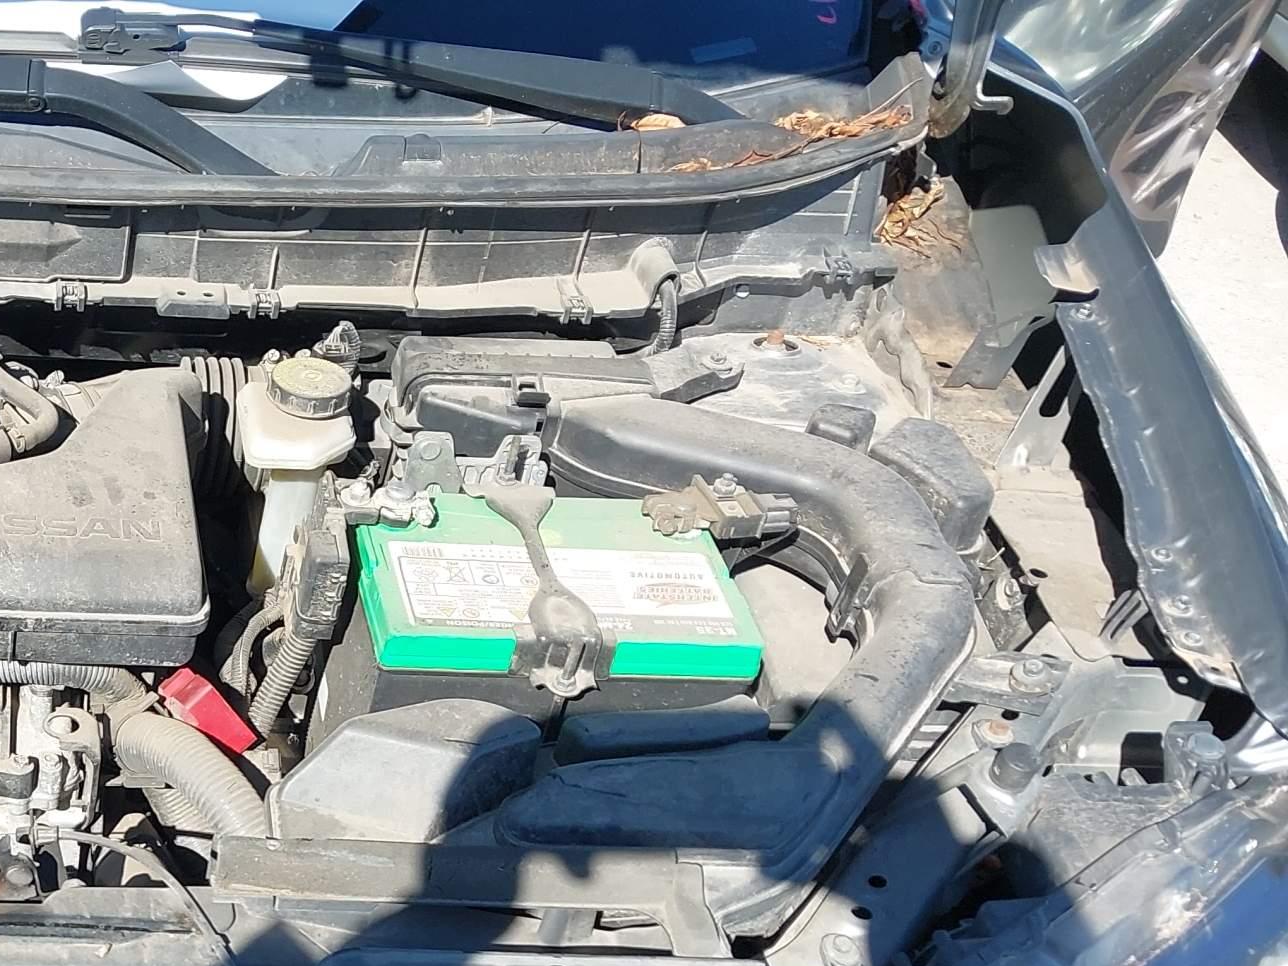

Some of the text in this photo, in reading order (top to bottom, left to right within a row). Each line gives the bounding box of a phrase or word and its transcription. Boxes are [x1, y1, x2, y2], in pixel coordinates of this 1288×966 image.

[629, 571, 704, 580] AUTOMOTIVE
[640, 585, 712, 594] BATTERIES
[634, 592, 719, 601] INTERSTATE
